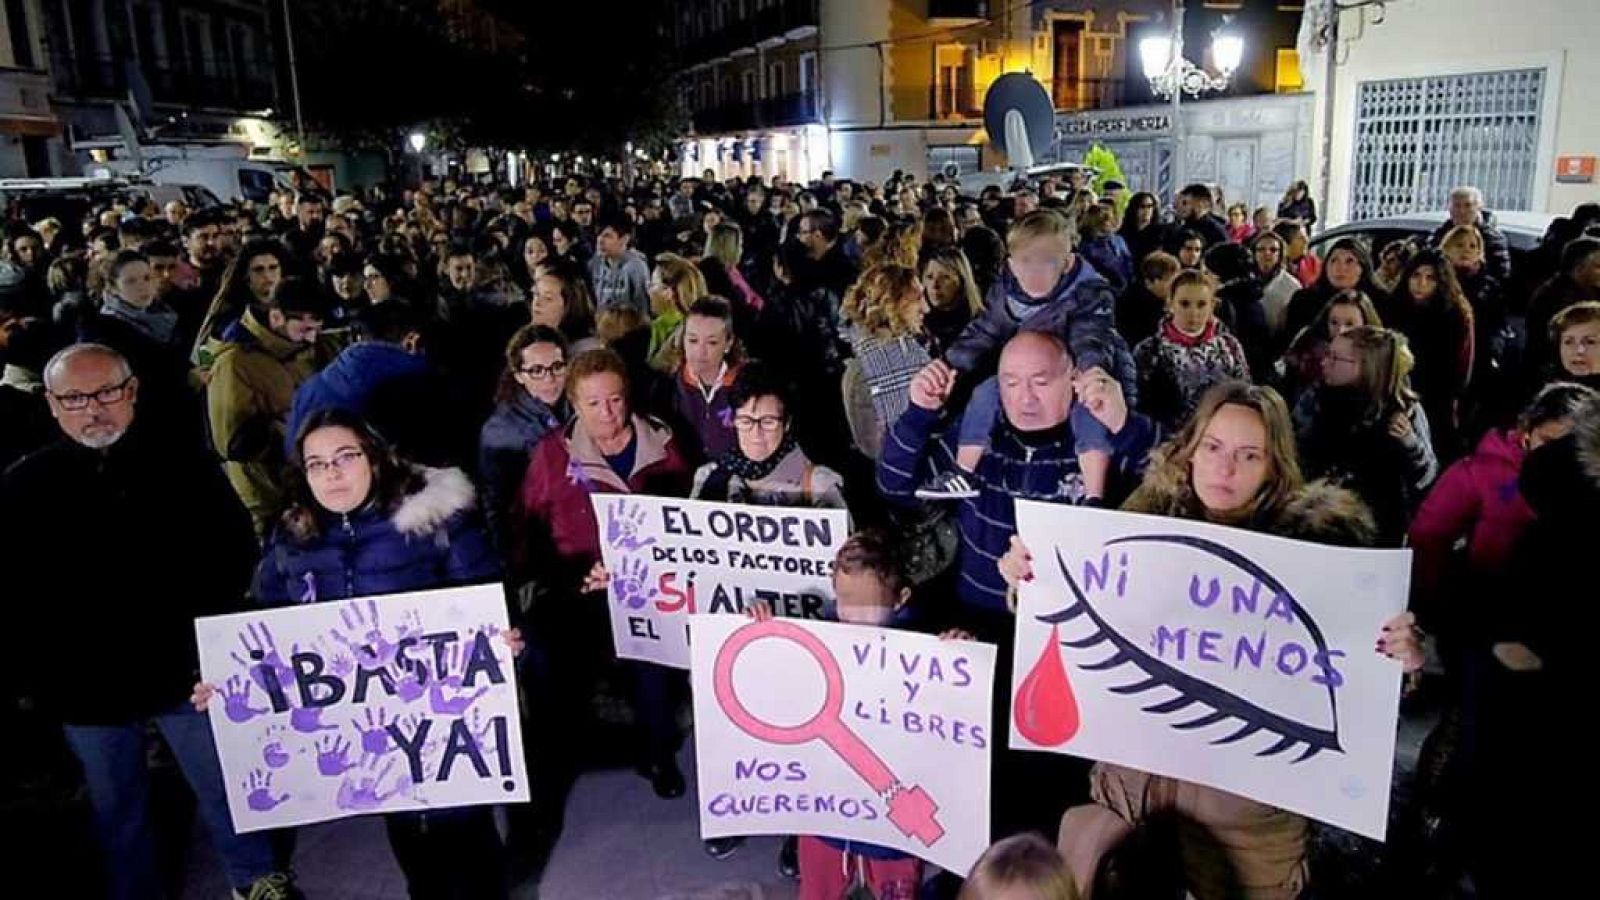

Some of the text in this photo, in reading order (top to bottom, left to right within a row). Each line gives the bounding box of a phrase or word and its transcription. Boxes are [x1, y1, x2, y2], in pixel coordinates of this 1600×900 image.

[1100, 116, 1171, 132] PERFUMERIA
[662, 506, 832, 547] EL ORDEN
[653, 547, 678, 562] DE
[683, 547, 720, 565] LOS
[1188, 574, 1296, 623] UNA
[628, 616, 661, 640] EL
[1156, 625, 1346, 688] MENOS
[903, 680, 920, 703] Y
[386, 716, 515, 793] YA!
[735, 758, 808, 782] NOS
[707, 794, 879, 820] QUEREMOS
